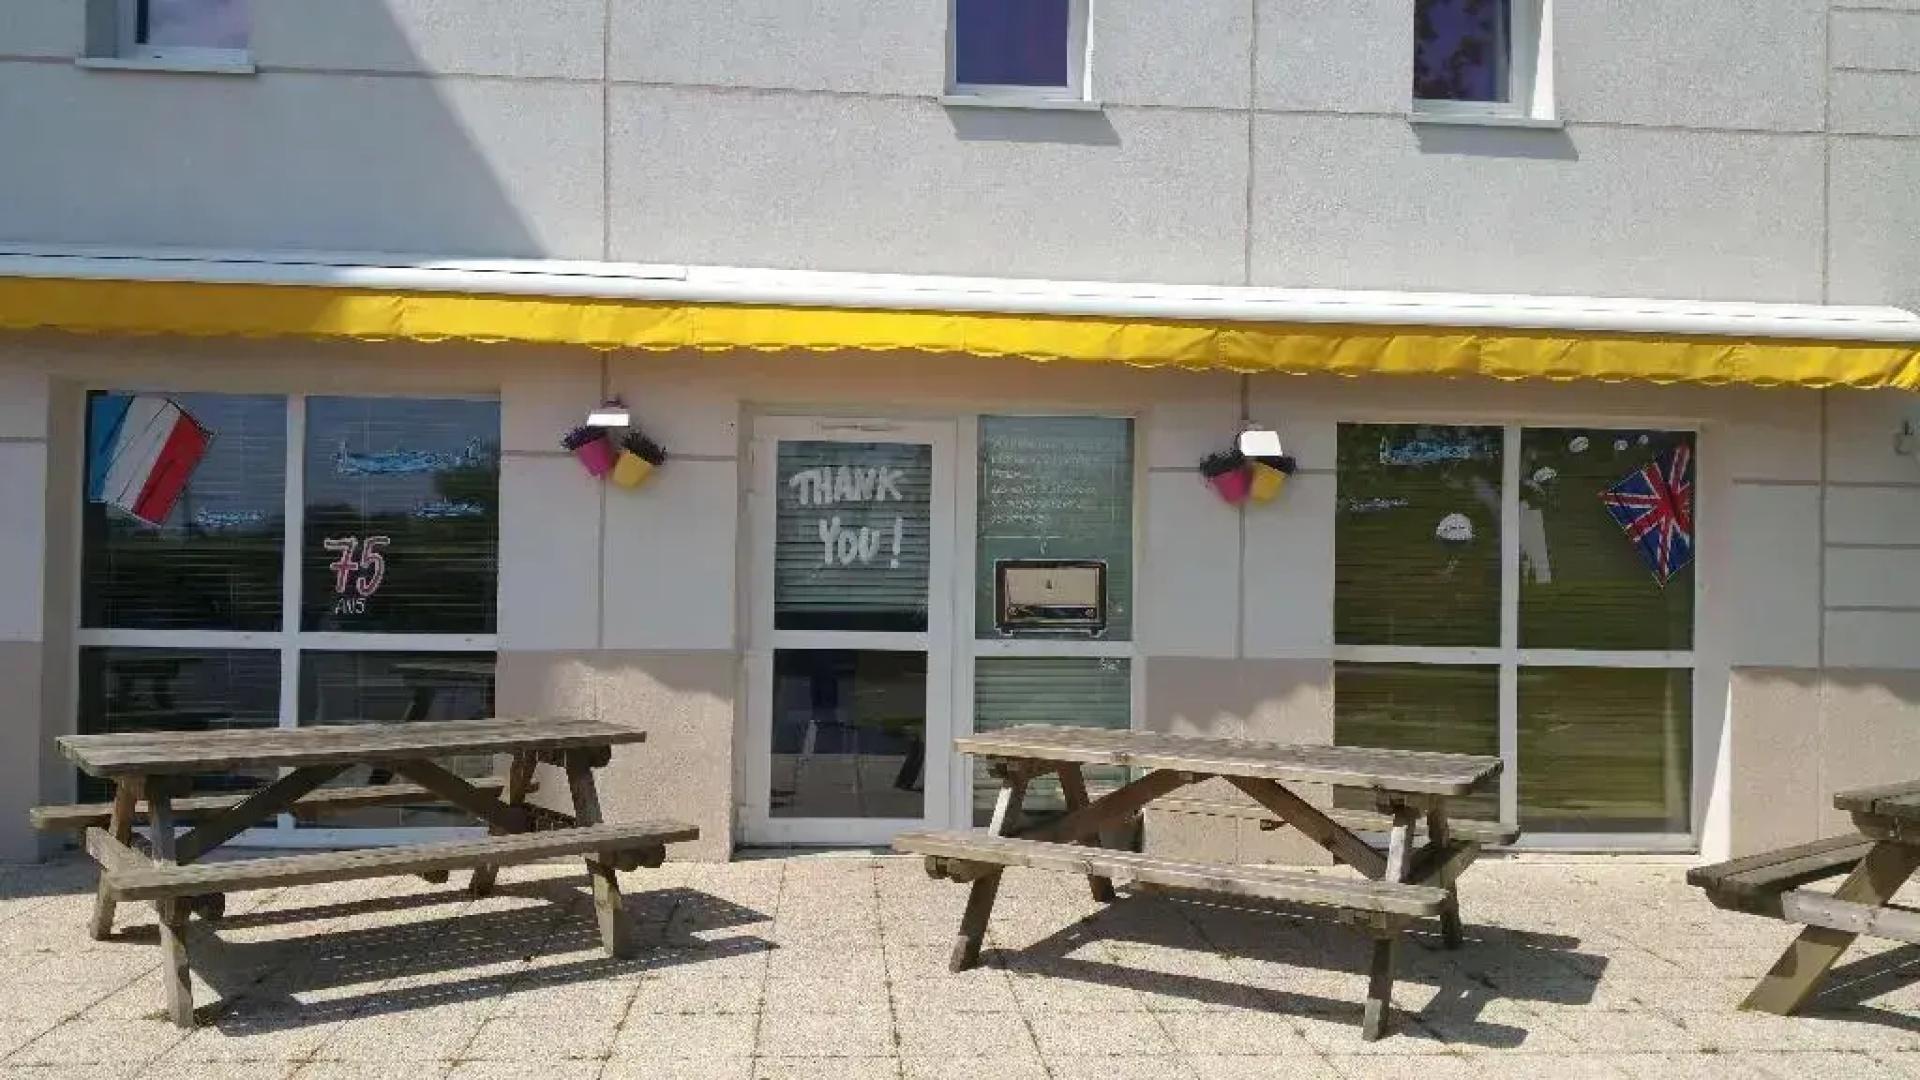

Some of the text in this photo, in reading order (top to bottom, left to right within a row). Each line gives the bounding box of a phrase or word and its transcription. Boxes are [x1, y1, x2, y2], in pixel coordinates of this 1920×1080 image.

[789, 466, 902, 505] THANK
[323, 535, 391, 596] 75
[334, 597, 366, 614] ANS
